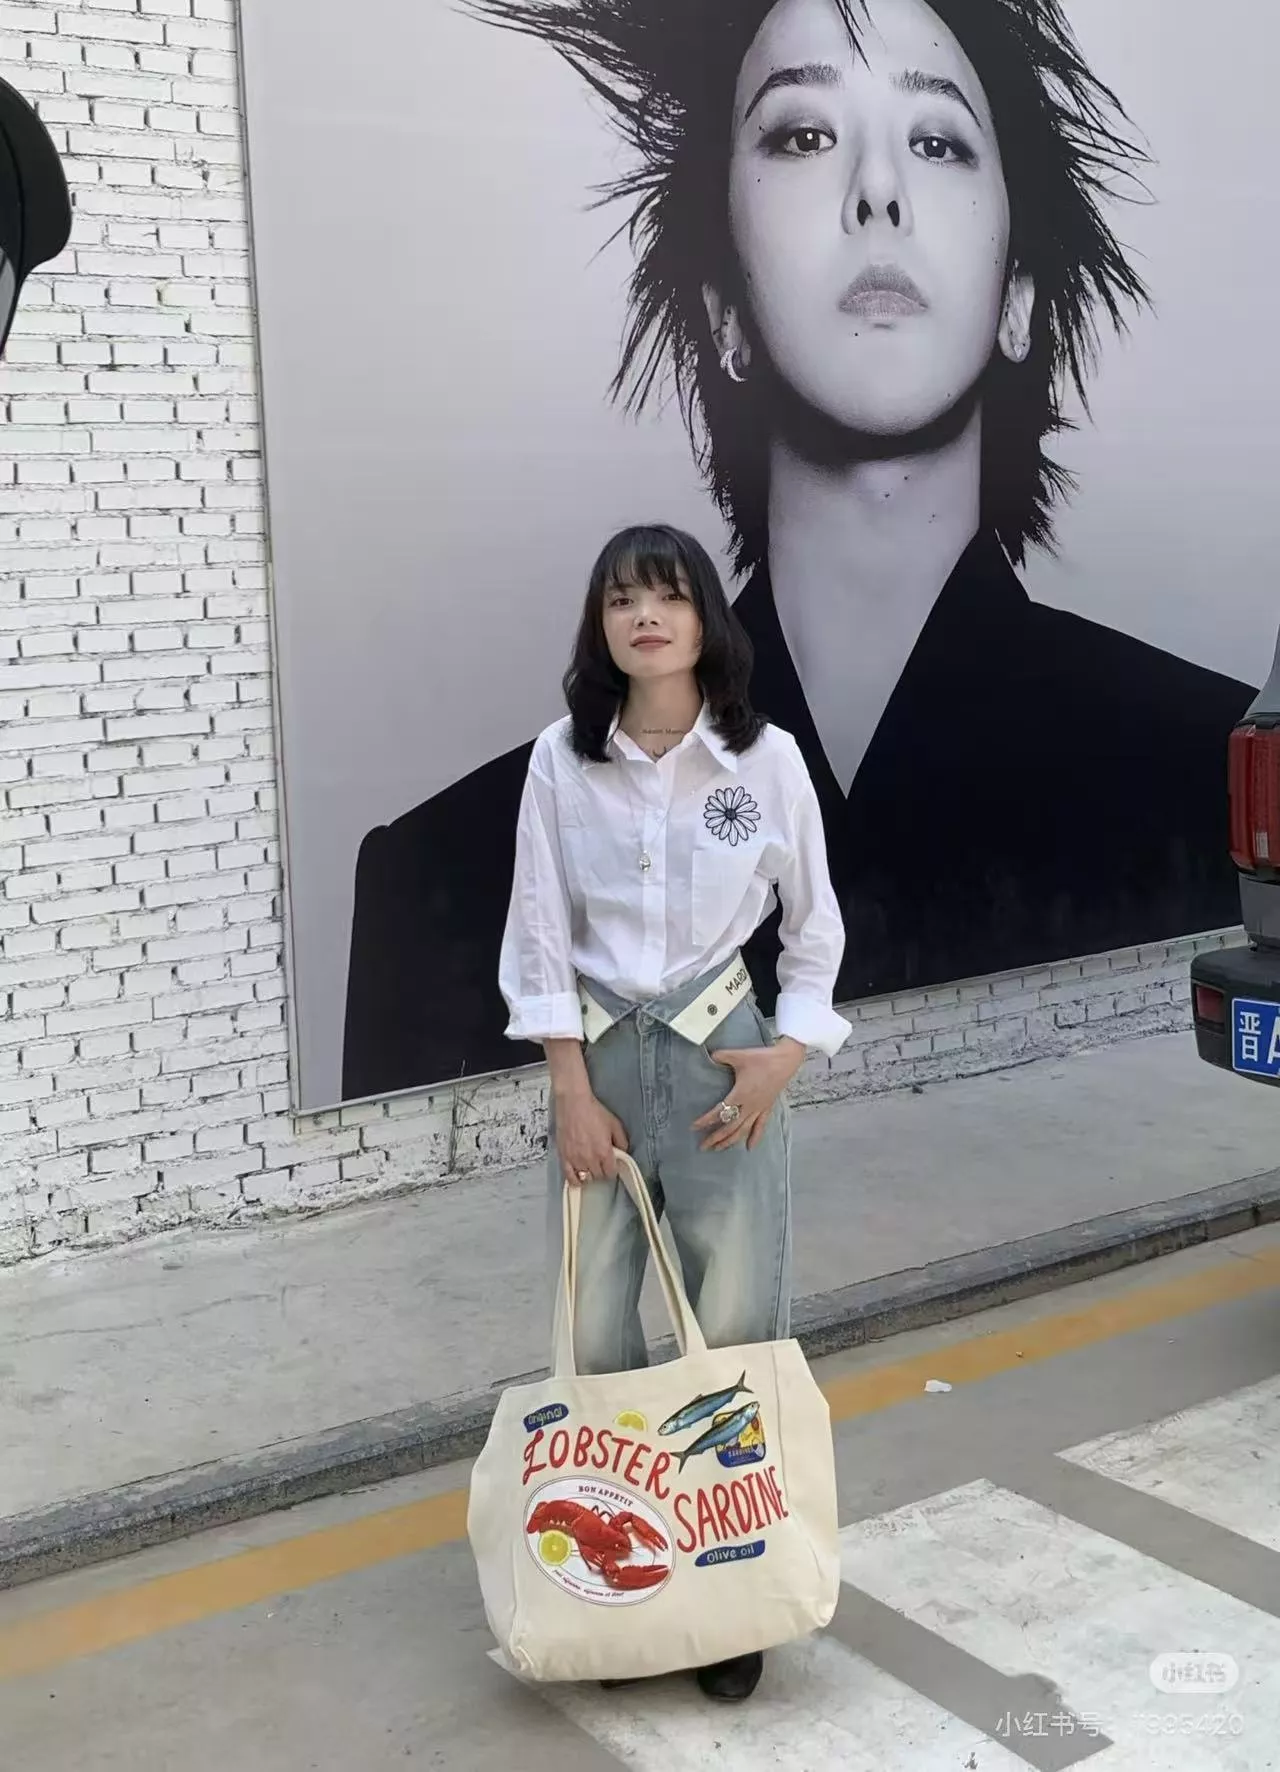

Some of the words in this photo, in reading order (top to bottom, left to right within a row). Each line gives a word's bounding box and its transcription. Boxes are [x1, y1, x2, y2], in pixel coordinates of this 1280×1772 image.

[522, 1425, 671, 1500] LOBSTER
[578, 1485, 597, 1493] BON
[706, 1549, 738, 1563] Olive
[740, 1544, 755, 1556] oil
